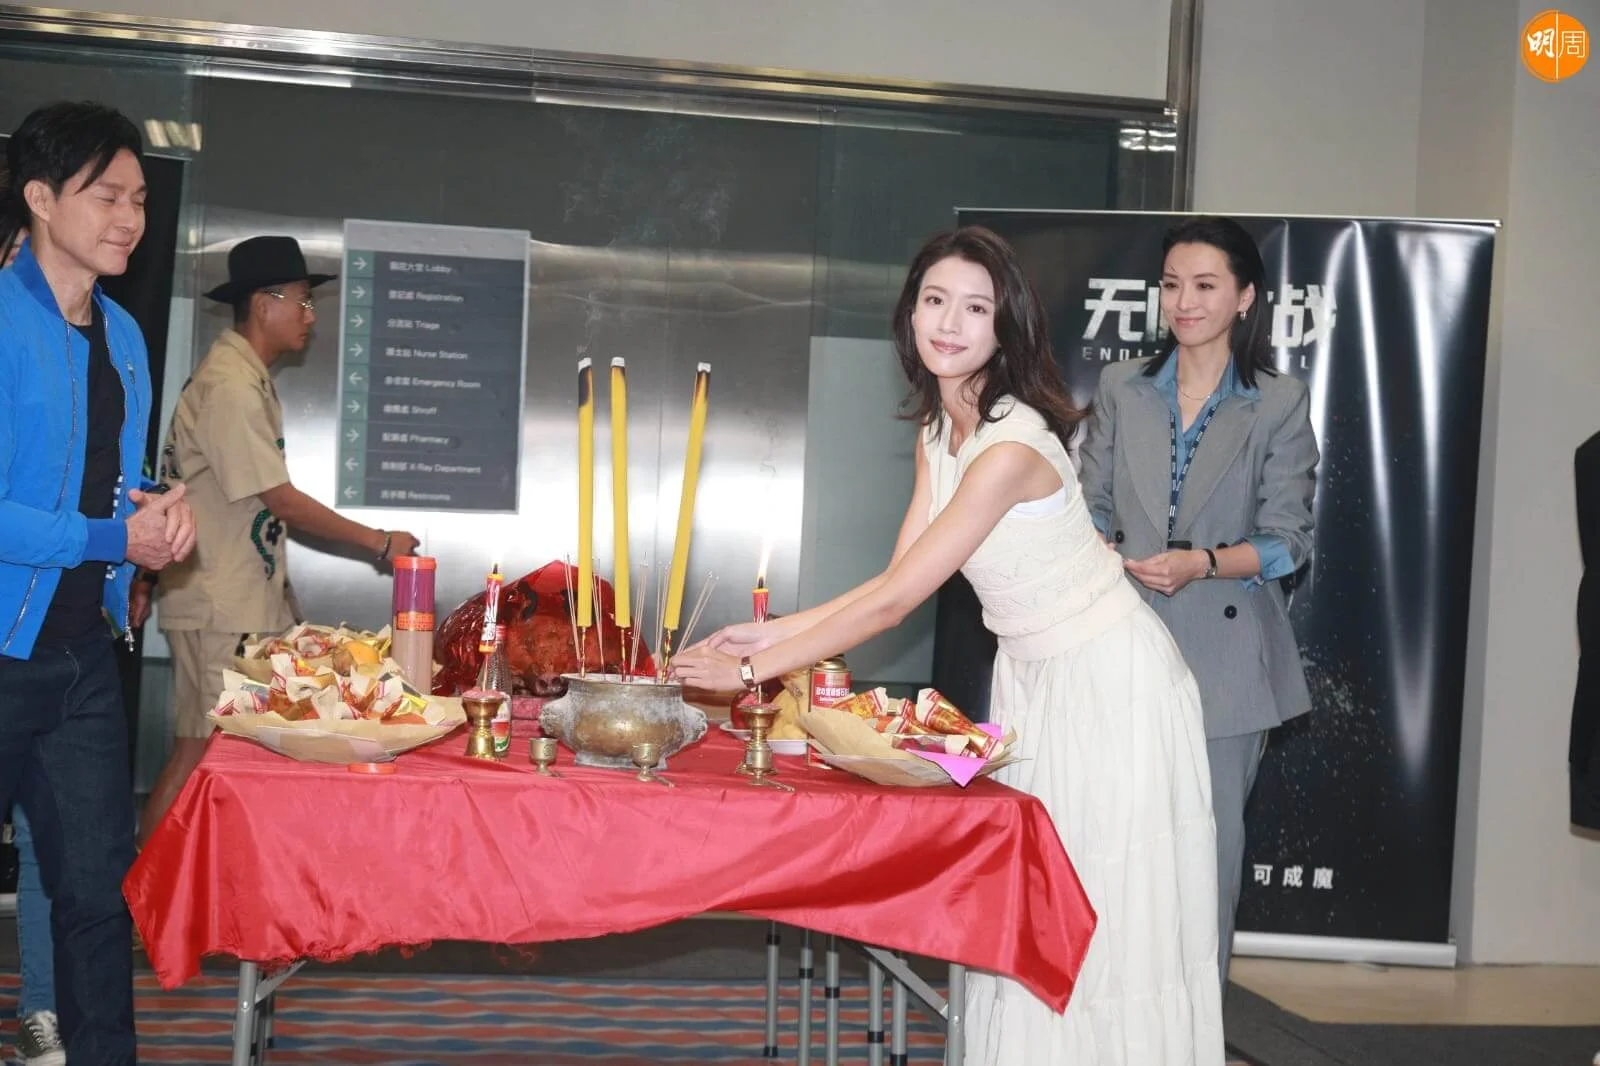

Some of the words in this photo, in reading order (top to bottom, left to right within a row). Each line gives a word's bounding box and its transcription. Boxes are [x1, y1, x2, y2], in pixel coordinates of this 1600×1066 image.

[426, 264, 452, 273] Lobby
[416, 292, 464, 302] Registration
[415, 321, 440, 330] Triage
[414, 349, 436, 357] Nurse
[439, 351, 467, 359] Station
[412, 377, 455, 388] Emergency
[458, 380, 480, 388] Room
[412, 406, 436, 414] Shroff
[410, 434, 448, 444] Pharmacy
[409, 463, 433, 472] X-Ray
[435, 464, 480, 473] Department
[408, 491, 450, 500] Restrooms
